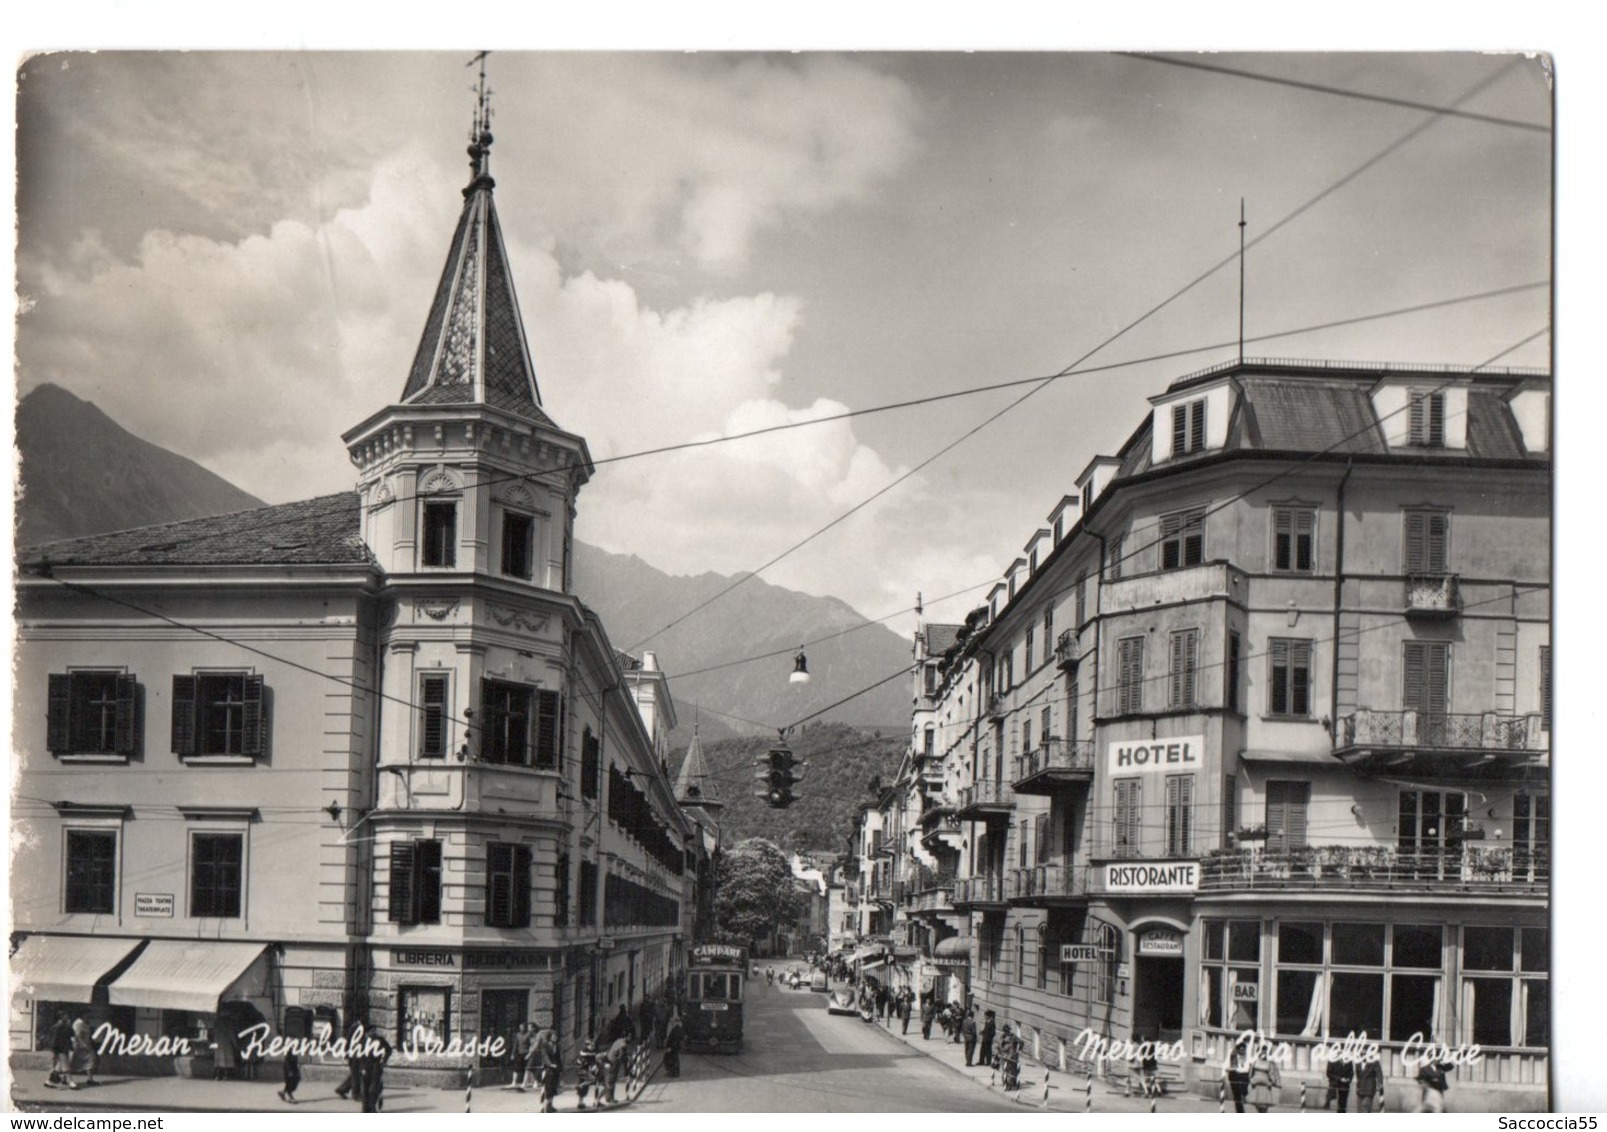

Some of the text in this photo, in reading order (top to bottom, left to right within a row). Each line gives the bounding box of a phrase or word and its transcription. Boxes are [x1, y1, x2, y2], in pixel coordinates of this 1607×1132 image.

[1118, 743, 1195, 766] HOTEL
[1109, 866, 1194, 886] RISTORANTE
[693, 945, 741, 957] CAMPARI
[1142, 941, 1182, 951] RESTAURANT
[396, 951, 454, 966] LIBRERIA
[1063, 947, 1097, 959] HOTEL
[888, 955, 895, 964] P
[1235, 985, 1256, 998] BAR
